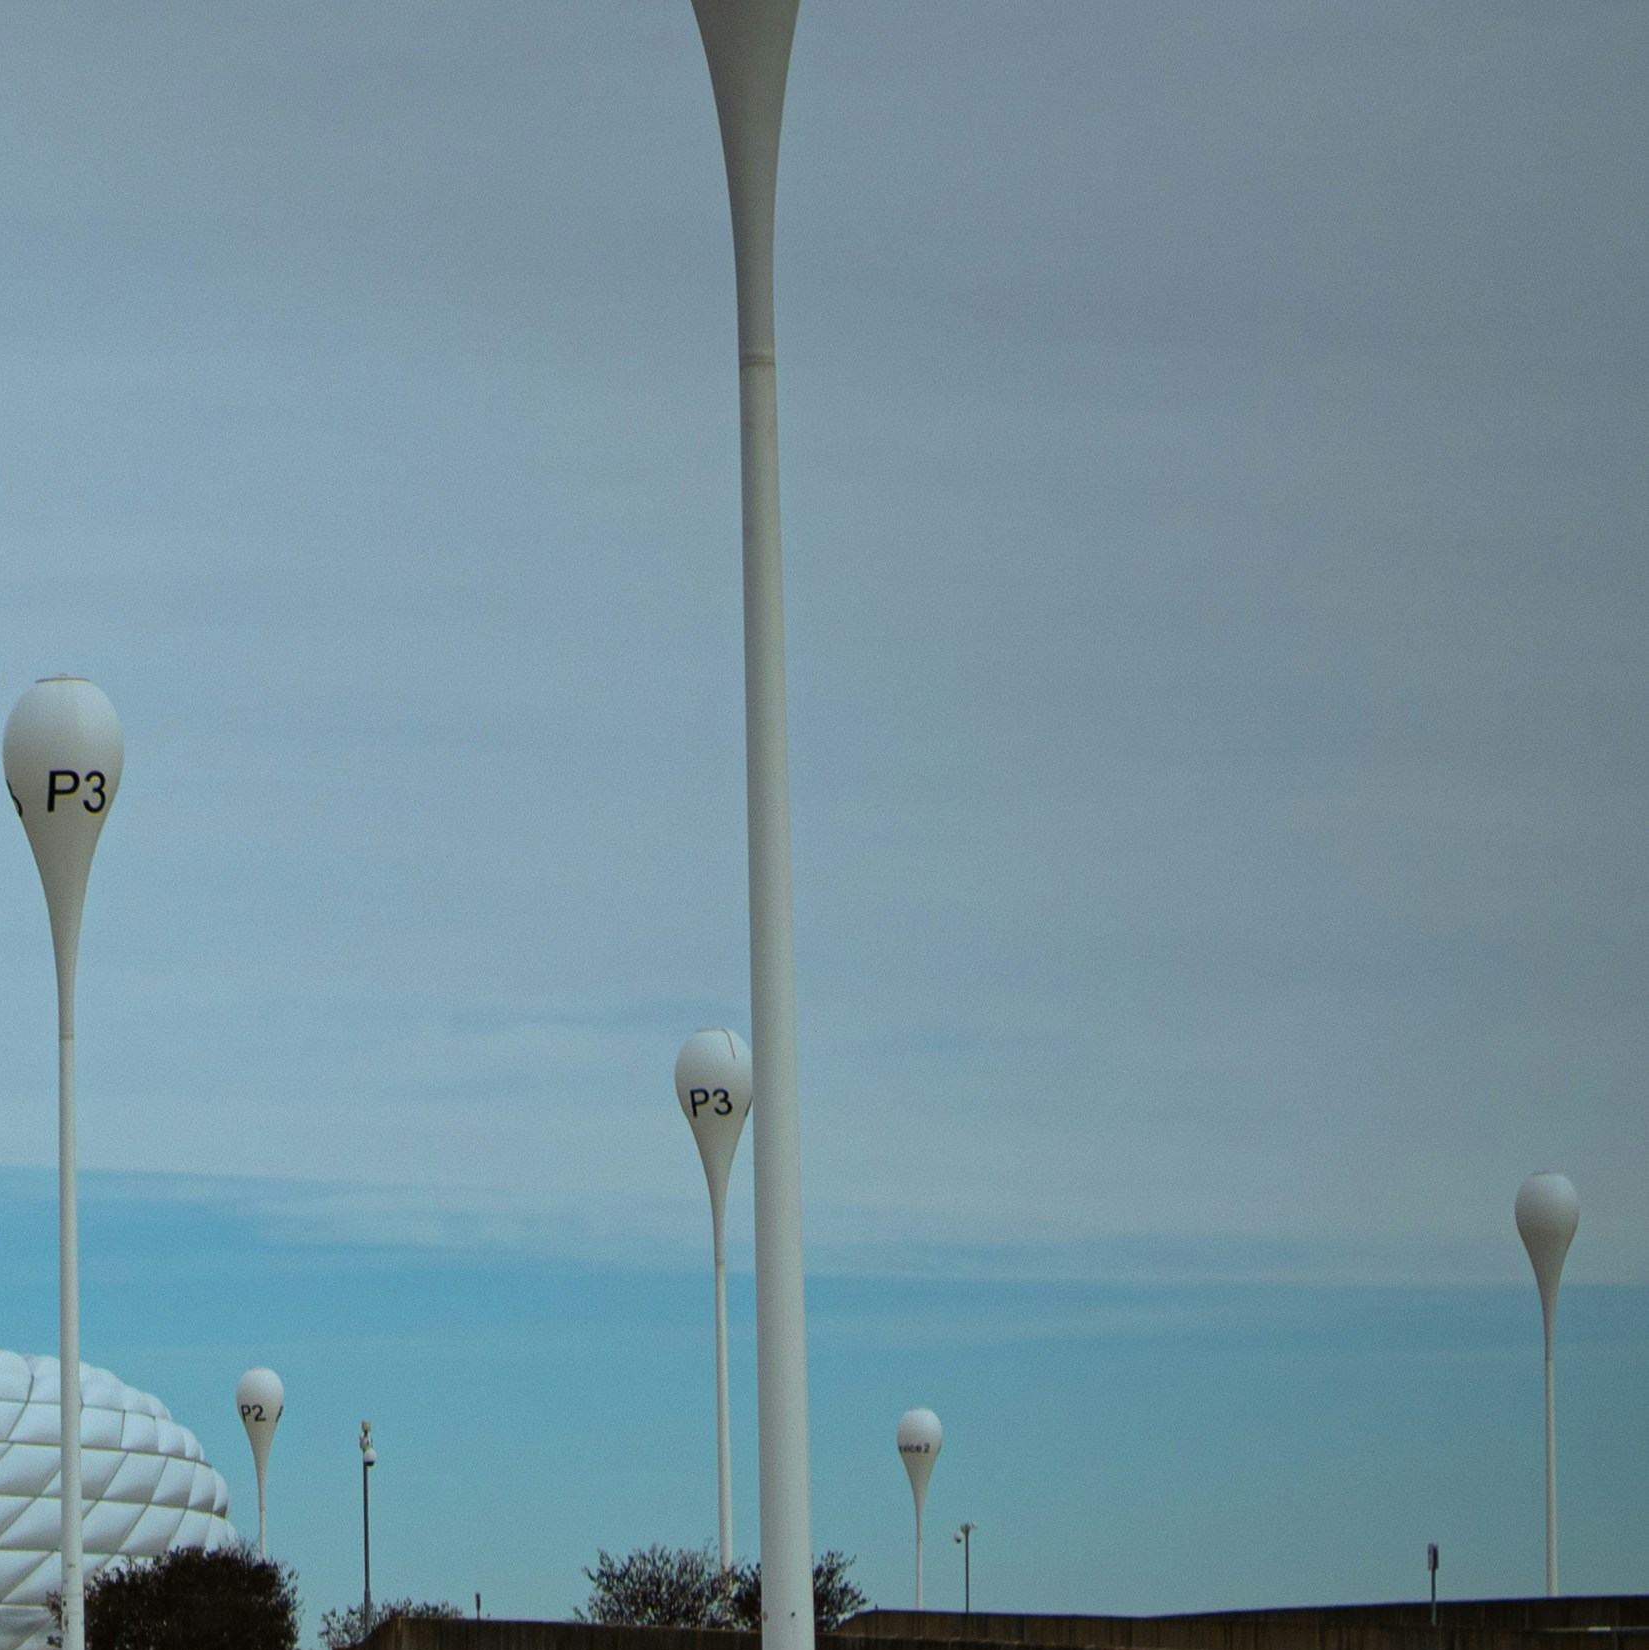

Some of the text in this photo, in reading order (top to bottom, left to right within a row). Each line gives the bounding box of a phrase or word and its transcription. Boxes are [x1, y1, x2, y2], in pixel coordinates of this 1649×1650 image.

[47, 770, 106, 813] P3
[690, 1088, 733, 1118] P3
[241, 1404, 267, 1422] P2
